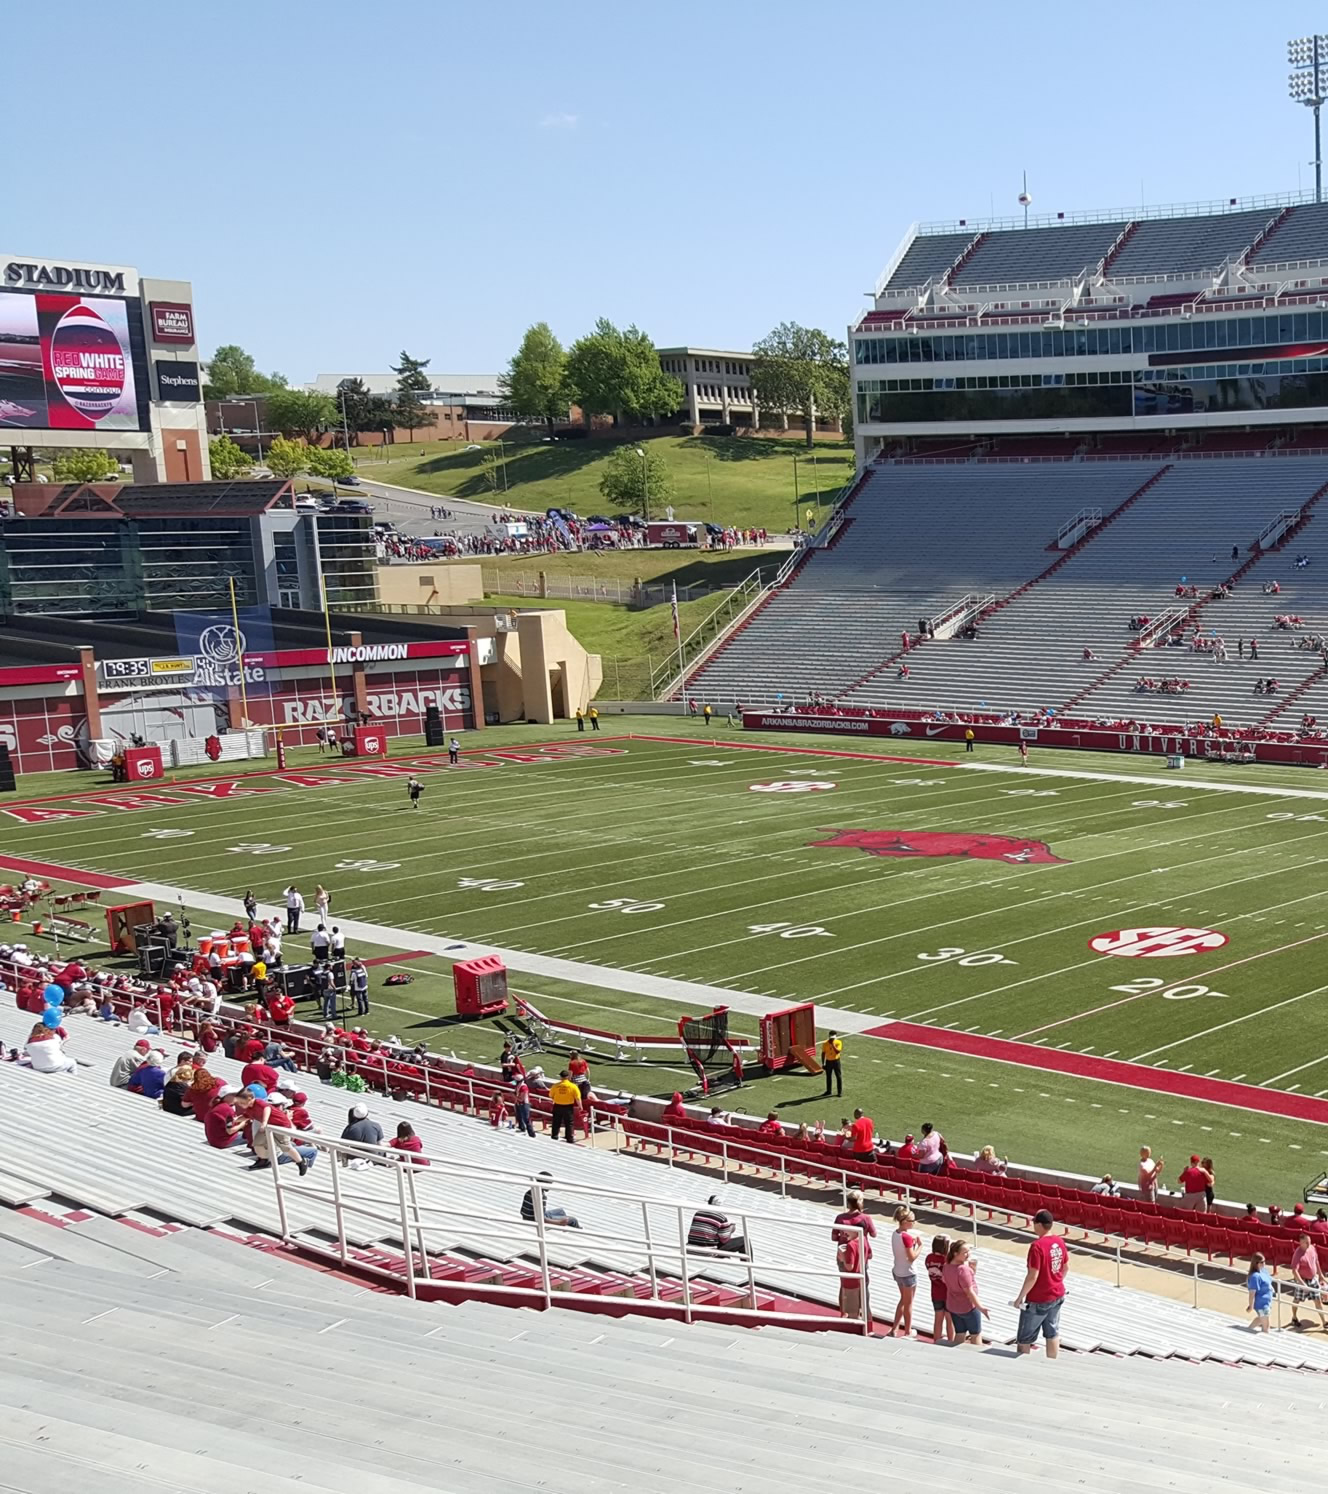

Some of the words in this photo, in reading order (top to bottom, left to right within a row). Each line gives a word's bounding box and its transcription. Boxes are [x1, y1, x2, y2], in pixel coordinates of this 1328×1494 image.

[6, 262, 126, 290] STADIUM
[158, 319, 188, 327] BUREAU
[165, 312, 187, 320] FARM
[161, 374, 198, 387] Stephens
[327, 644, 409, 663] UNCOMMON
[107, 660, 147, 676] 79:35
[98, 679, 137, 690] FRANK
[140, 674, 191, 687] BROYLES
[193, 666, 265, 687] Allstate
[761, 717, 869, 730] ARKANSASRAZORBACKS.COM
[139, 764, 153, 774] ups
[588, 898, 666, 914] 50
[747, 922, 826, 939] 40
[1090, 927, 1228, 957] SEC
[917, 947, 1004, 966] 30
[1108, 978, 1208, 999] 20
